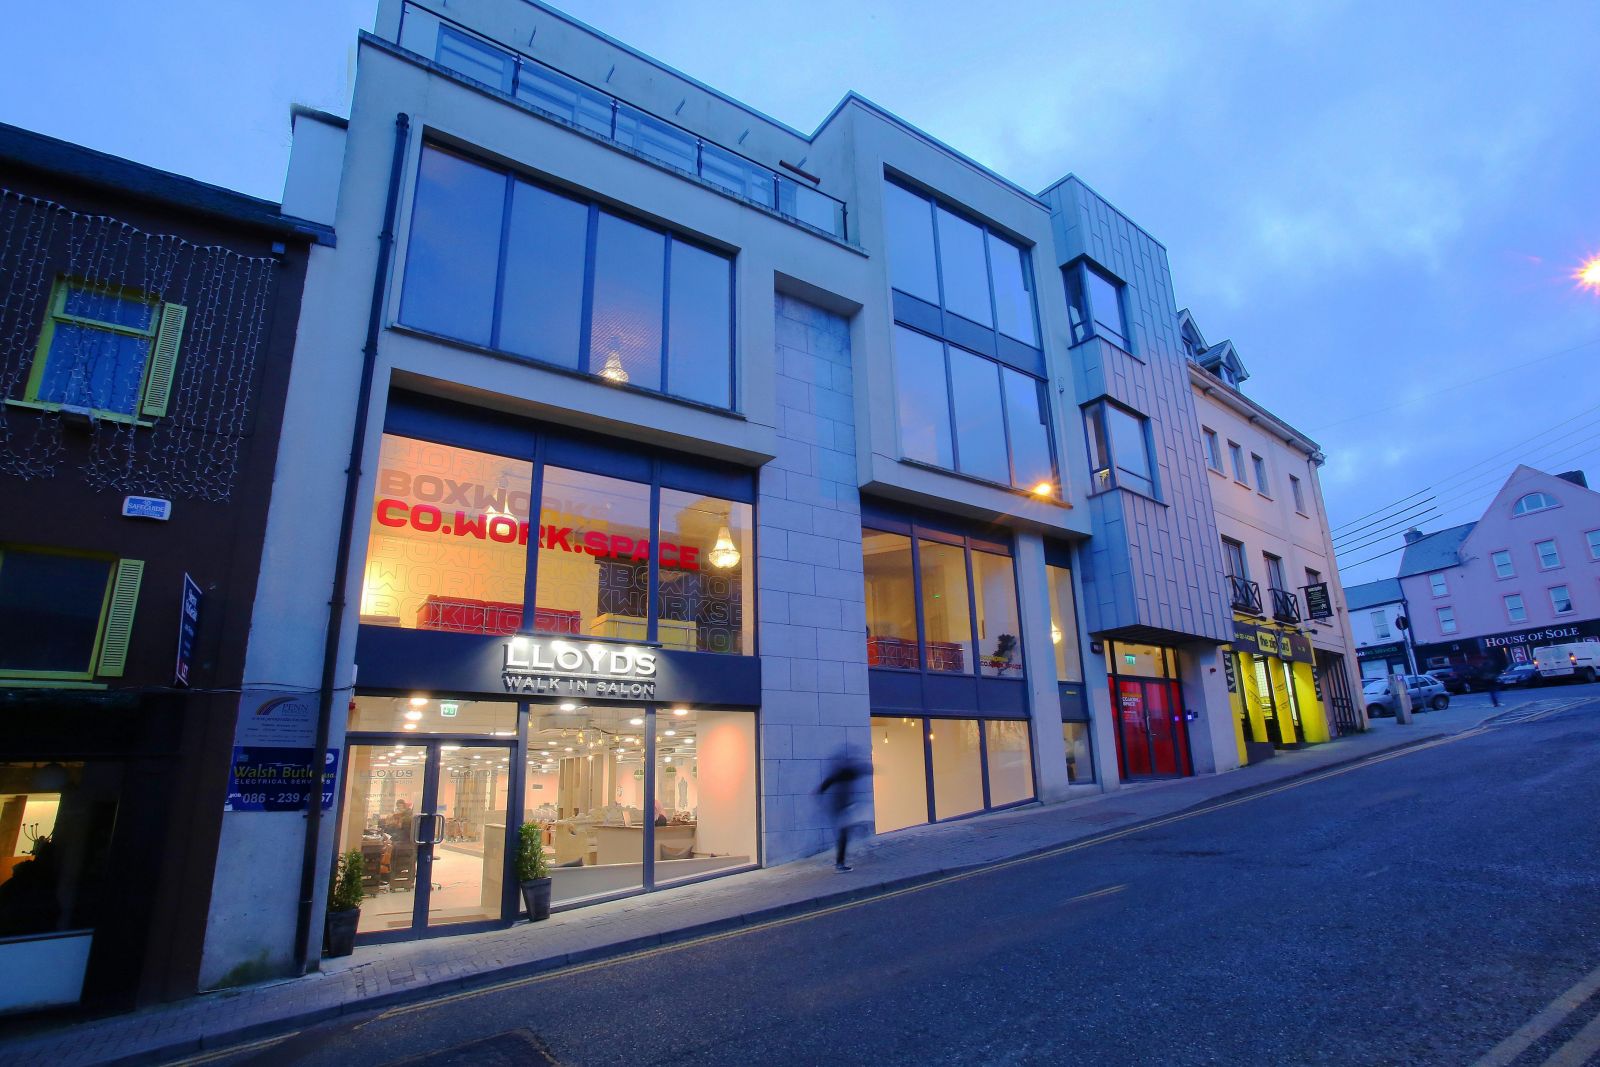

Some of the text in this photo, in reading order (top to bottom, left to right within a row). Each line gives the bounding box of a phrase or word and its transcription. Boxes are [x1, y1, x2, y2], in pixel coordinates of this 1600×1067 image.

[1485, 627, 1580, 648] HOUSE OF SOLE
[506, 642, 656, 675] LLOYDS
[505, 674, 655, 698] WALK IN SALON
[282, 703, 309, 712] PENN
[233, 763, 277, 779] Walsh
[242, 792, 266, 803] 086
[276, 793, 300, 803] 239
